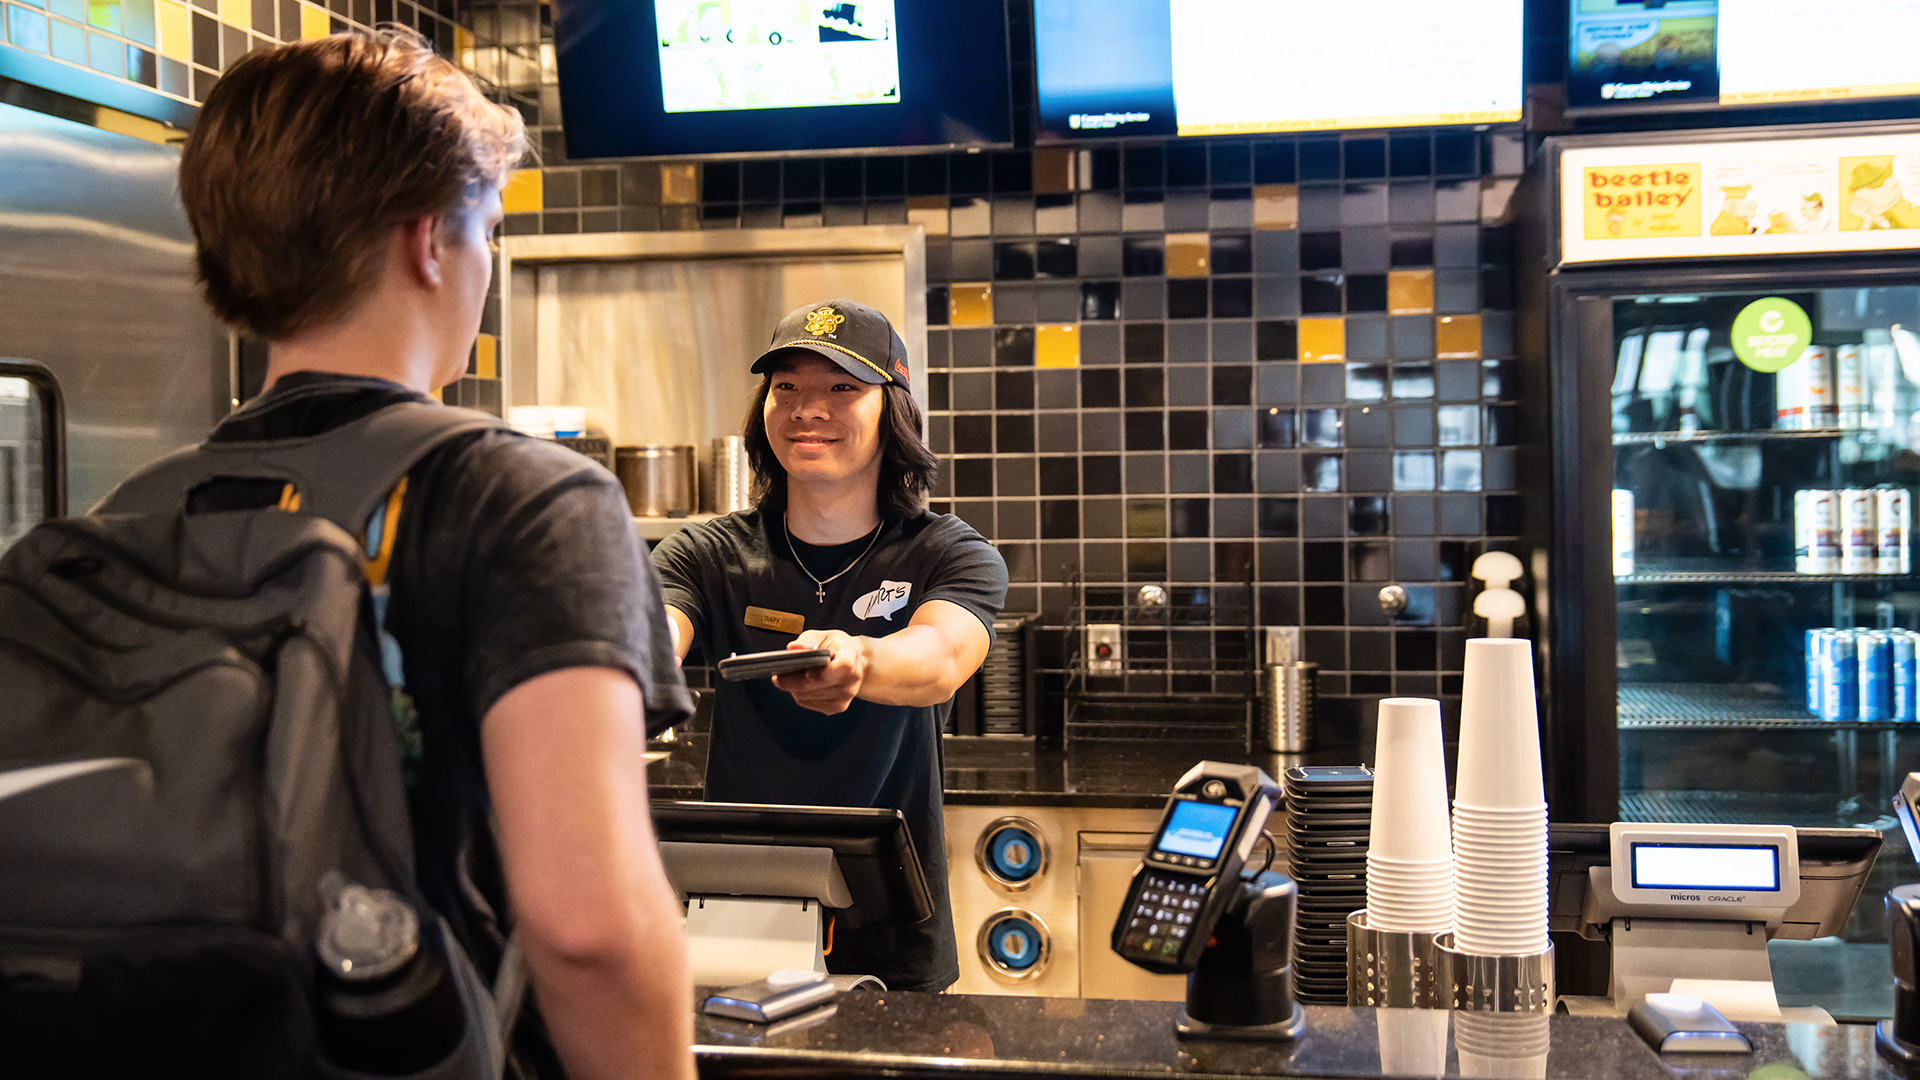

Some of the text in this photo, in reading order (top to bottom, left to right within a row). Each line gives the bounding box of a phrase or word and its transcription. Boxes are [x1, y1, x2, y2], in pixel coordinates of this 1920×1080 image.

[1588, 170, 1689, 188] beetle
[1592, 187, 1694, 208] bailey
[1670, 893, 1701, 901] micros
